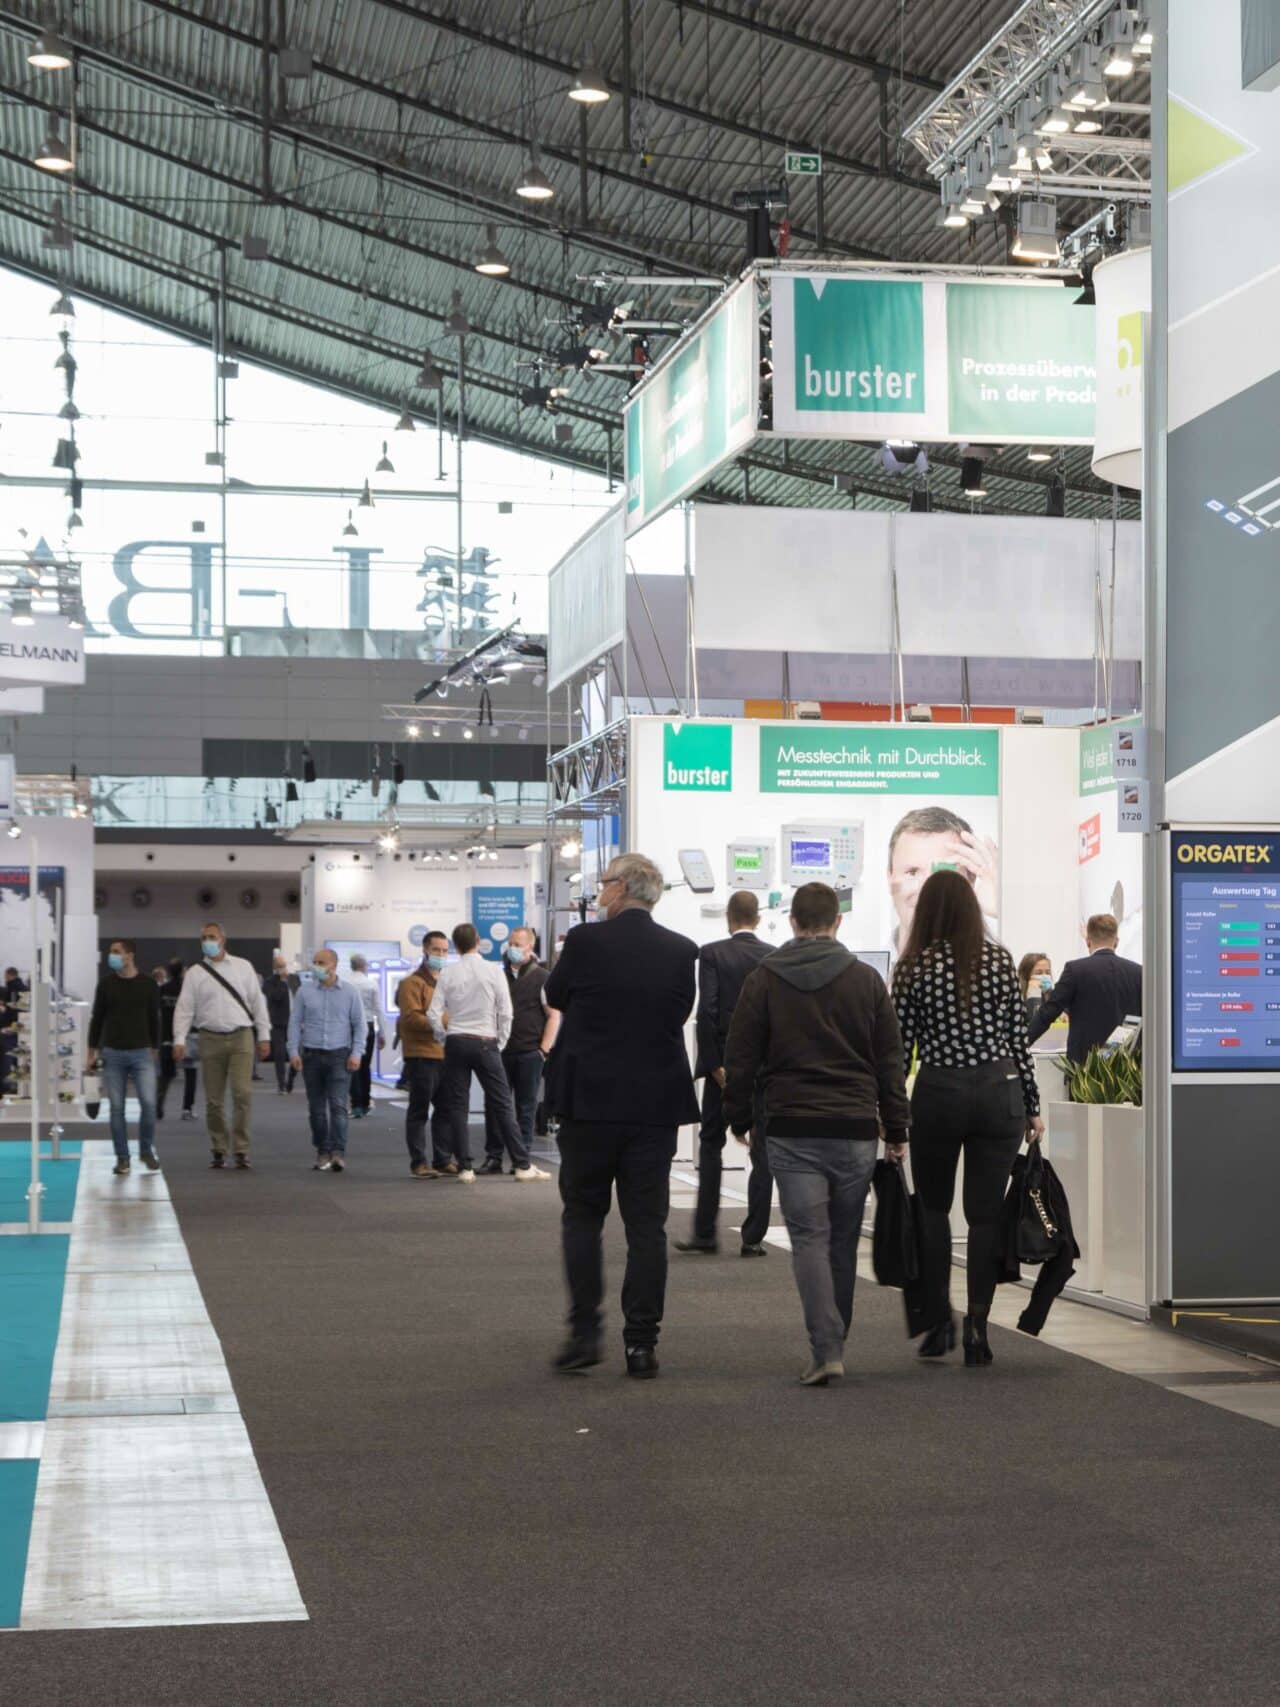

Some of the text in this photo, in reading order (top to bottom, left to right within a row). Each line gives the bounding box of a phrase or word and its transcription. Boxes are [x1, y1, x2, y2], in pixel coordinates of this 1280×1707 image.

[804, 354, 917, 399] burster
[961, 357, 1095, 379] Prozessüberw
[980, 384, 998, 402] in
[1005, 384, 1038, 403] der
[777, 746, 987, 767] Messtechnik mit Durchblick.
[1116, 758, 1137, 767] 1718
[667, 761, 728, 786] burster
[1120, 812, 1142, 821] 1720
[1177, 843, 1271, 864] ORGATEX
[1212, 887, 1277, 897] Auswertung Tag
